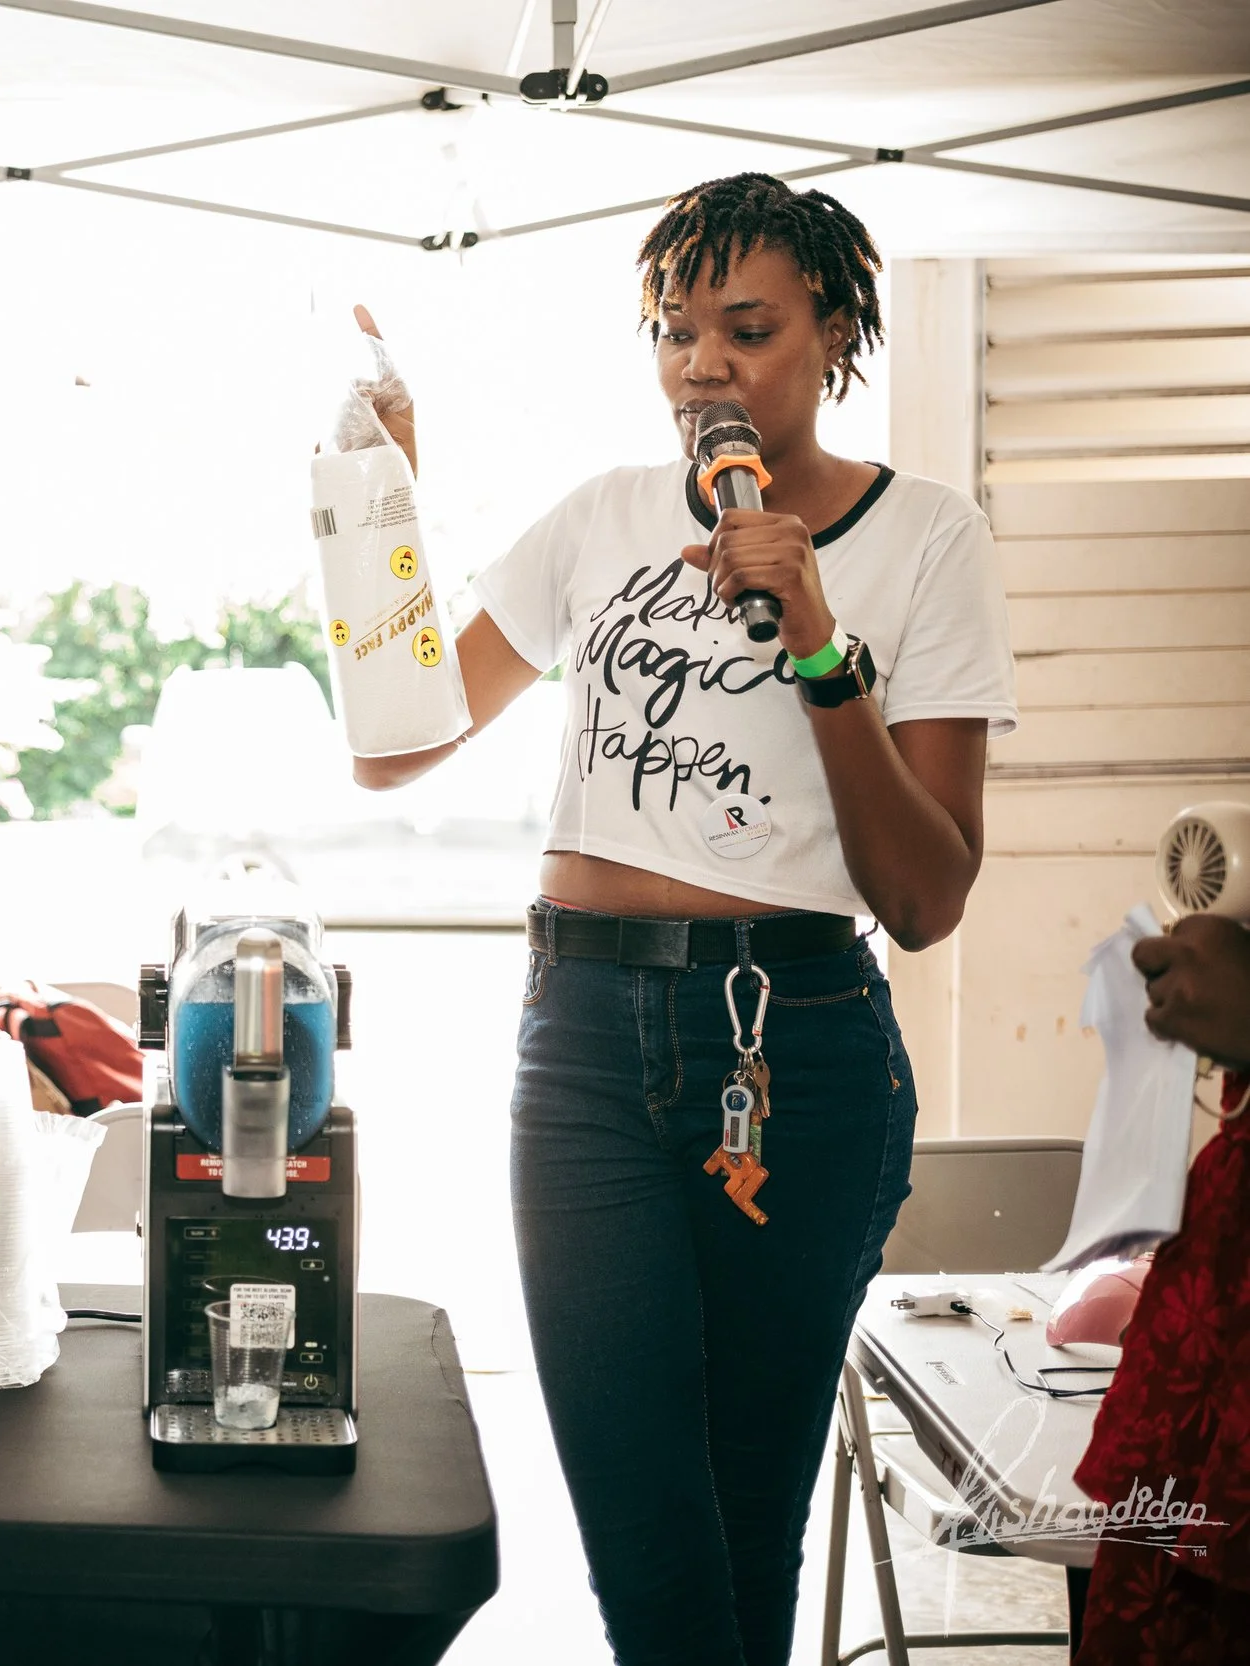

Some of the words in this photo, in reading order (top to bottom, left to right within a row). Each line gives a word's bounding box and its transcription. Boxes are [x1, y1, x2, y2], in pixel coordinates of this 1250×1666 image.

[591, 558, 743, 632] Mak
[388, 591, 434, 641] HAPPY
[354, 633, 384, 662] FACE
[200, 1158, 224, 1168] REMOV
[266, 1227, 310, 1251] 43.9
